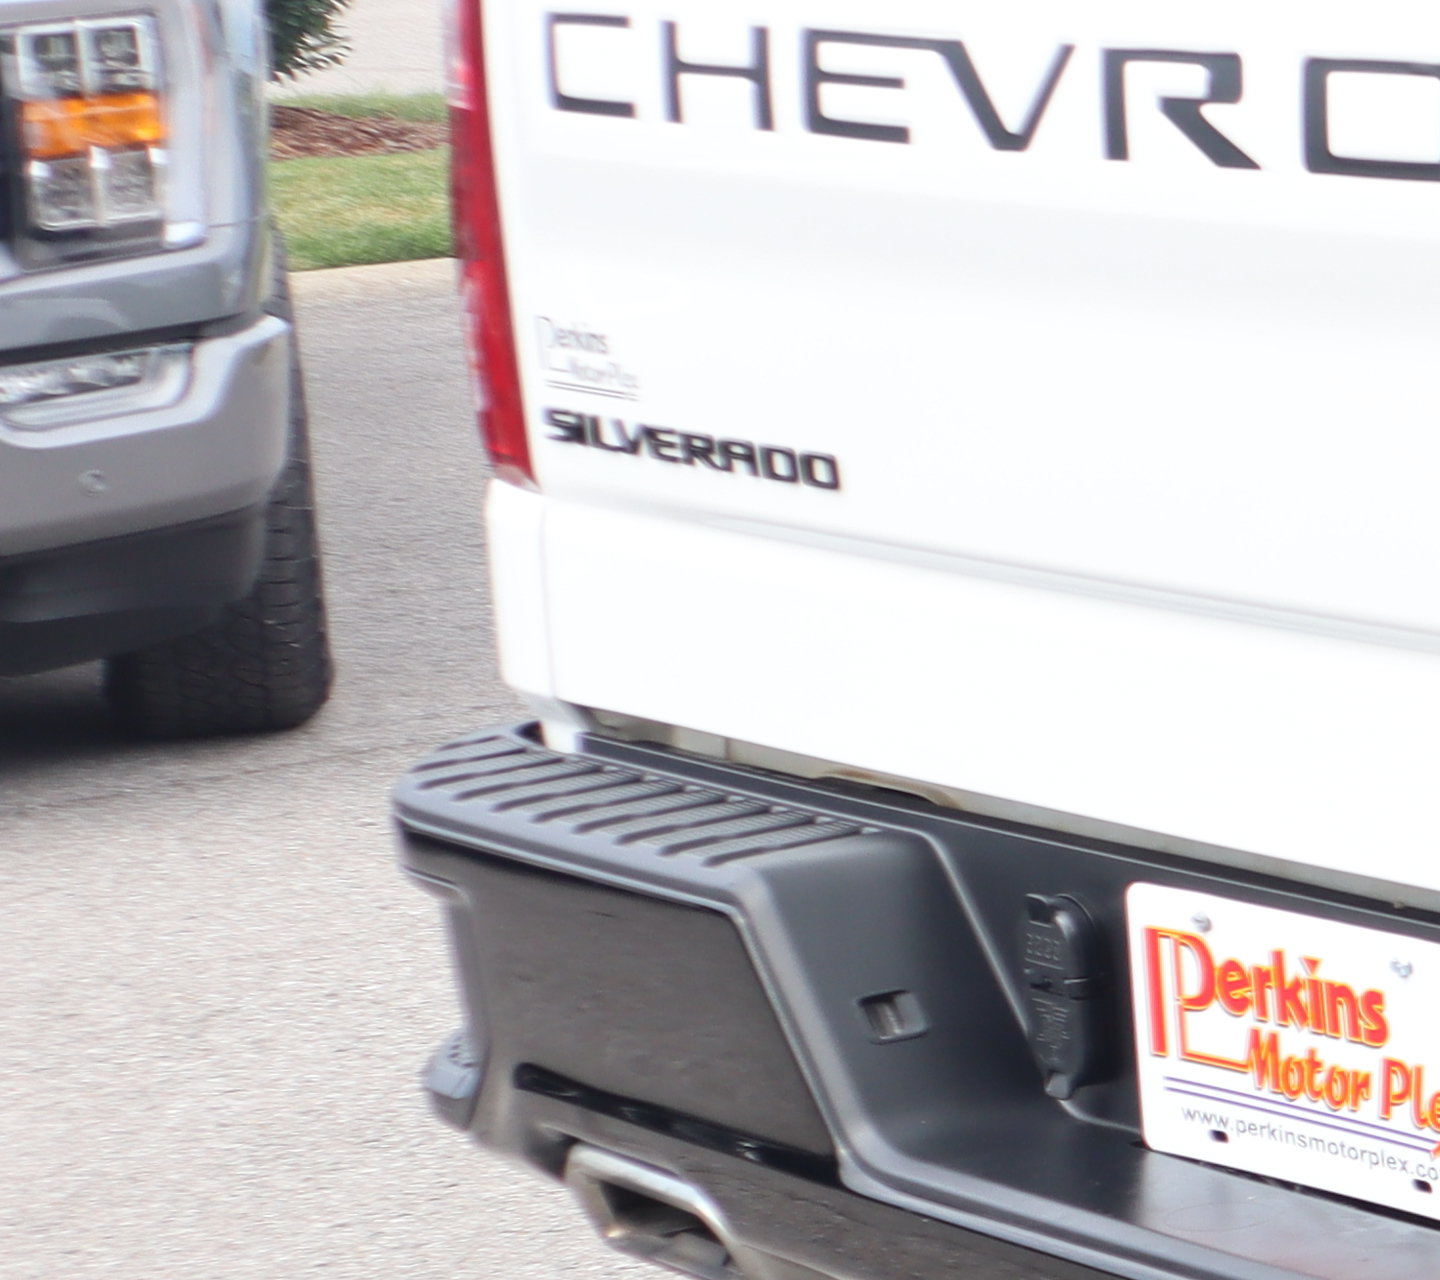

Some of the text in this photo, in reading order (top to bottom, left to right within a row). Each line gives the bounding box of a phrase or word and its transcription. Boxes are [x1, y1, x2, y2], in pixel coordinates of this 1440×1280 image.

[542, 406, 842, 490] SILVERADO
[1142, 925, 1390, 1060] Perkins
[1248, 1026, 1371, 1111] Motor
